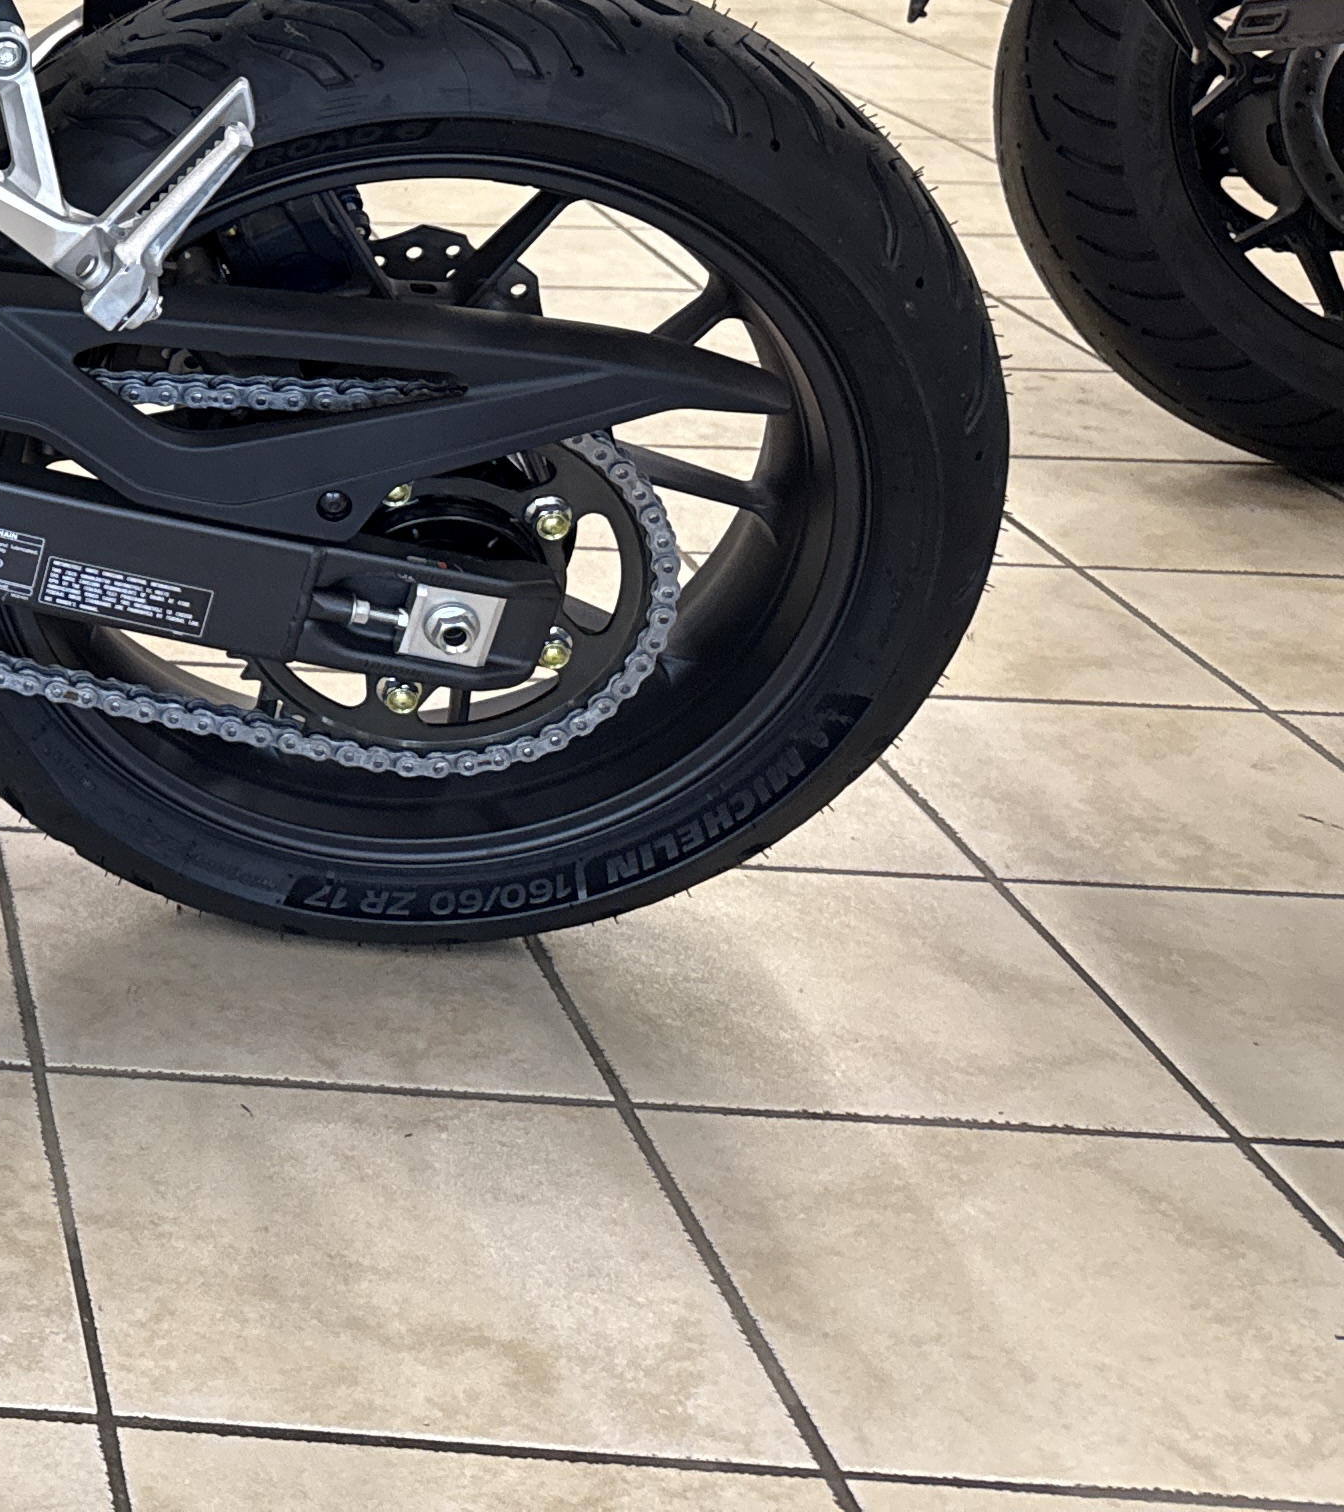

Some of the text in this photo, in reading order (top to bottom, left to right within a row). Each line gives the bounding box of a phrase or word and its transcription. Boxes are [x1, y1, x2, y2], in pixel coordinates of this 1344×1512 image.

[607, 755, 806, 885] MICHELIN
[302, 873, 572, 915] 160/60 ZR 17
